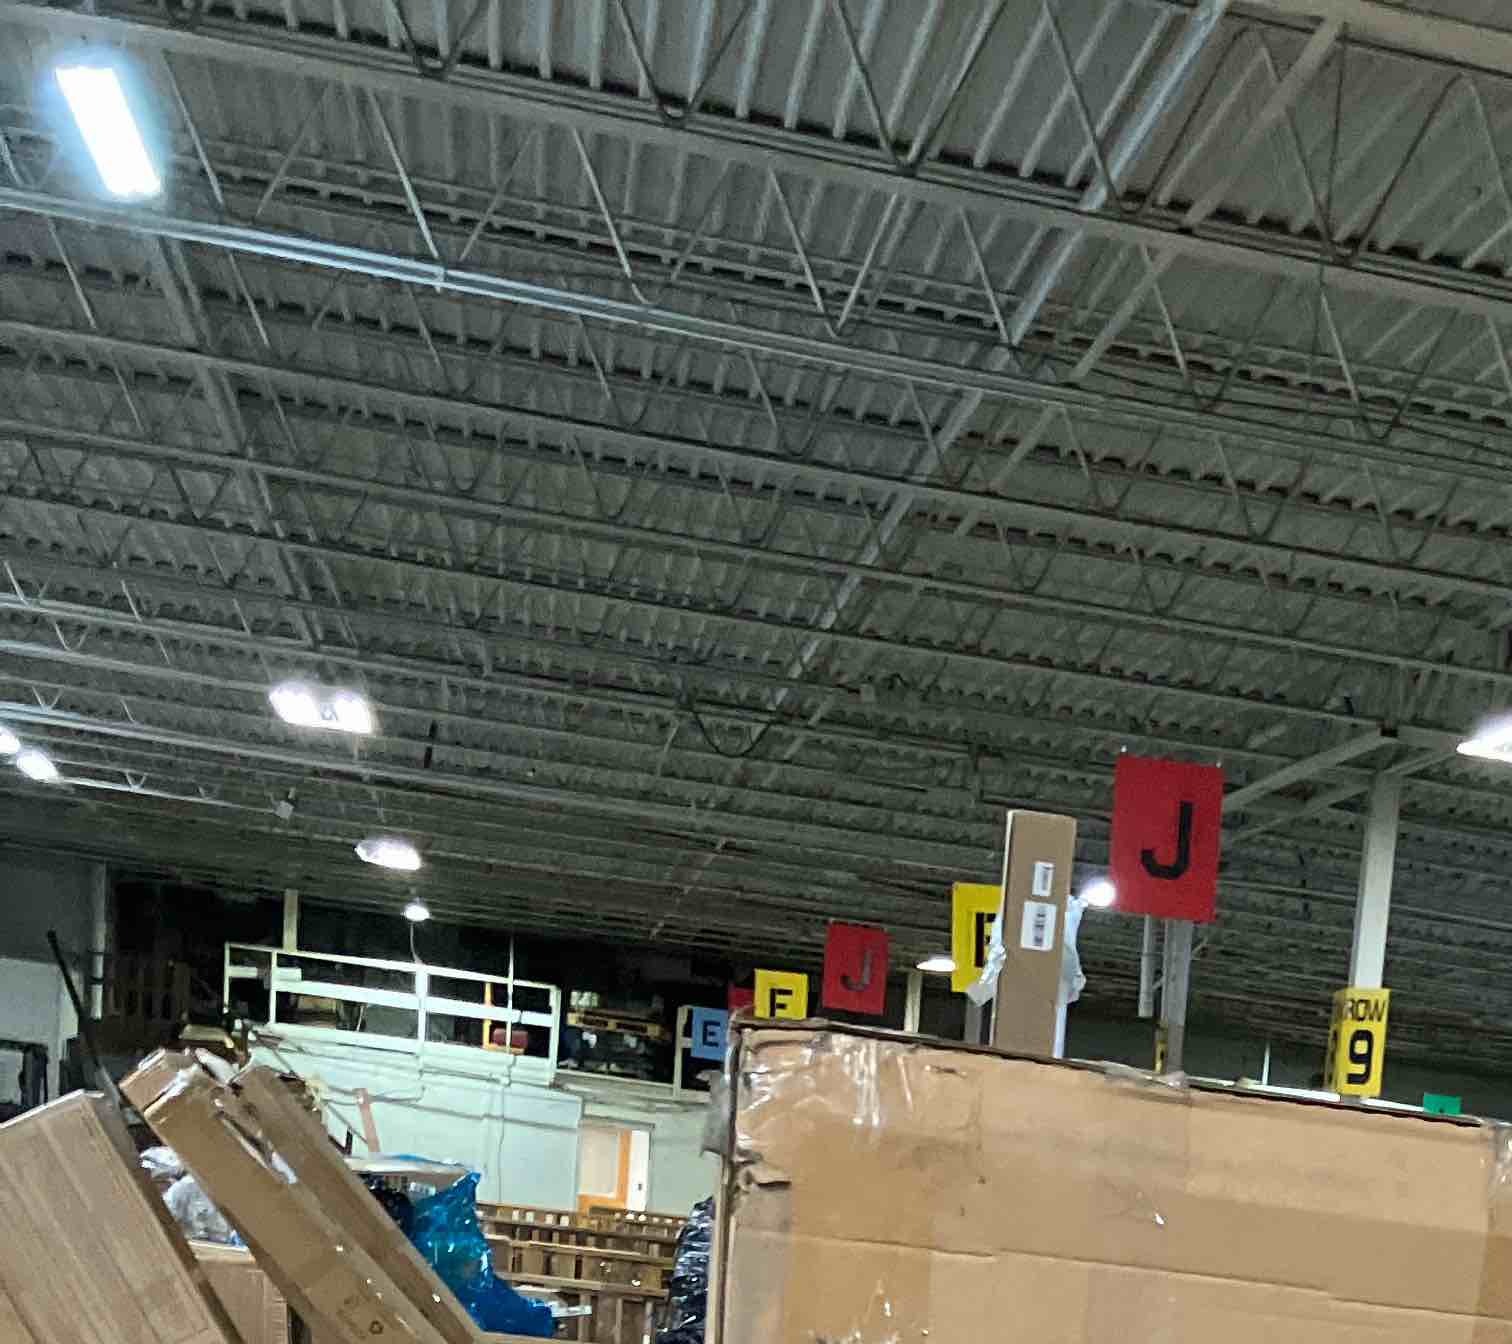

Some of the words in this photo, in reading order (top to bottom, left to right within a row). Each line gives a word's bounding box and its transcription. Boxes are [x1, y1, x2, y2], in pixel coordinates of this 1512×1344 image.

[1140, 801, 1193, 880] J
[840, 947, 872, 992] J
[702, 1021, 720, 1047] E
[1346, 1029, 1375, 1085] 9
